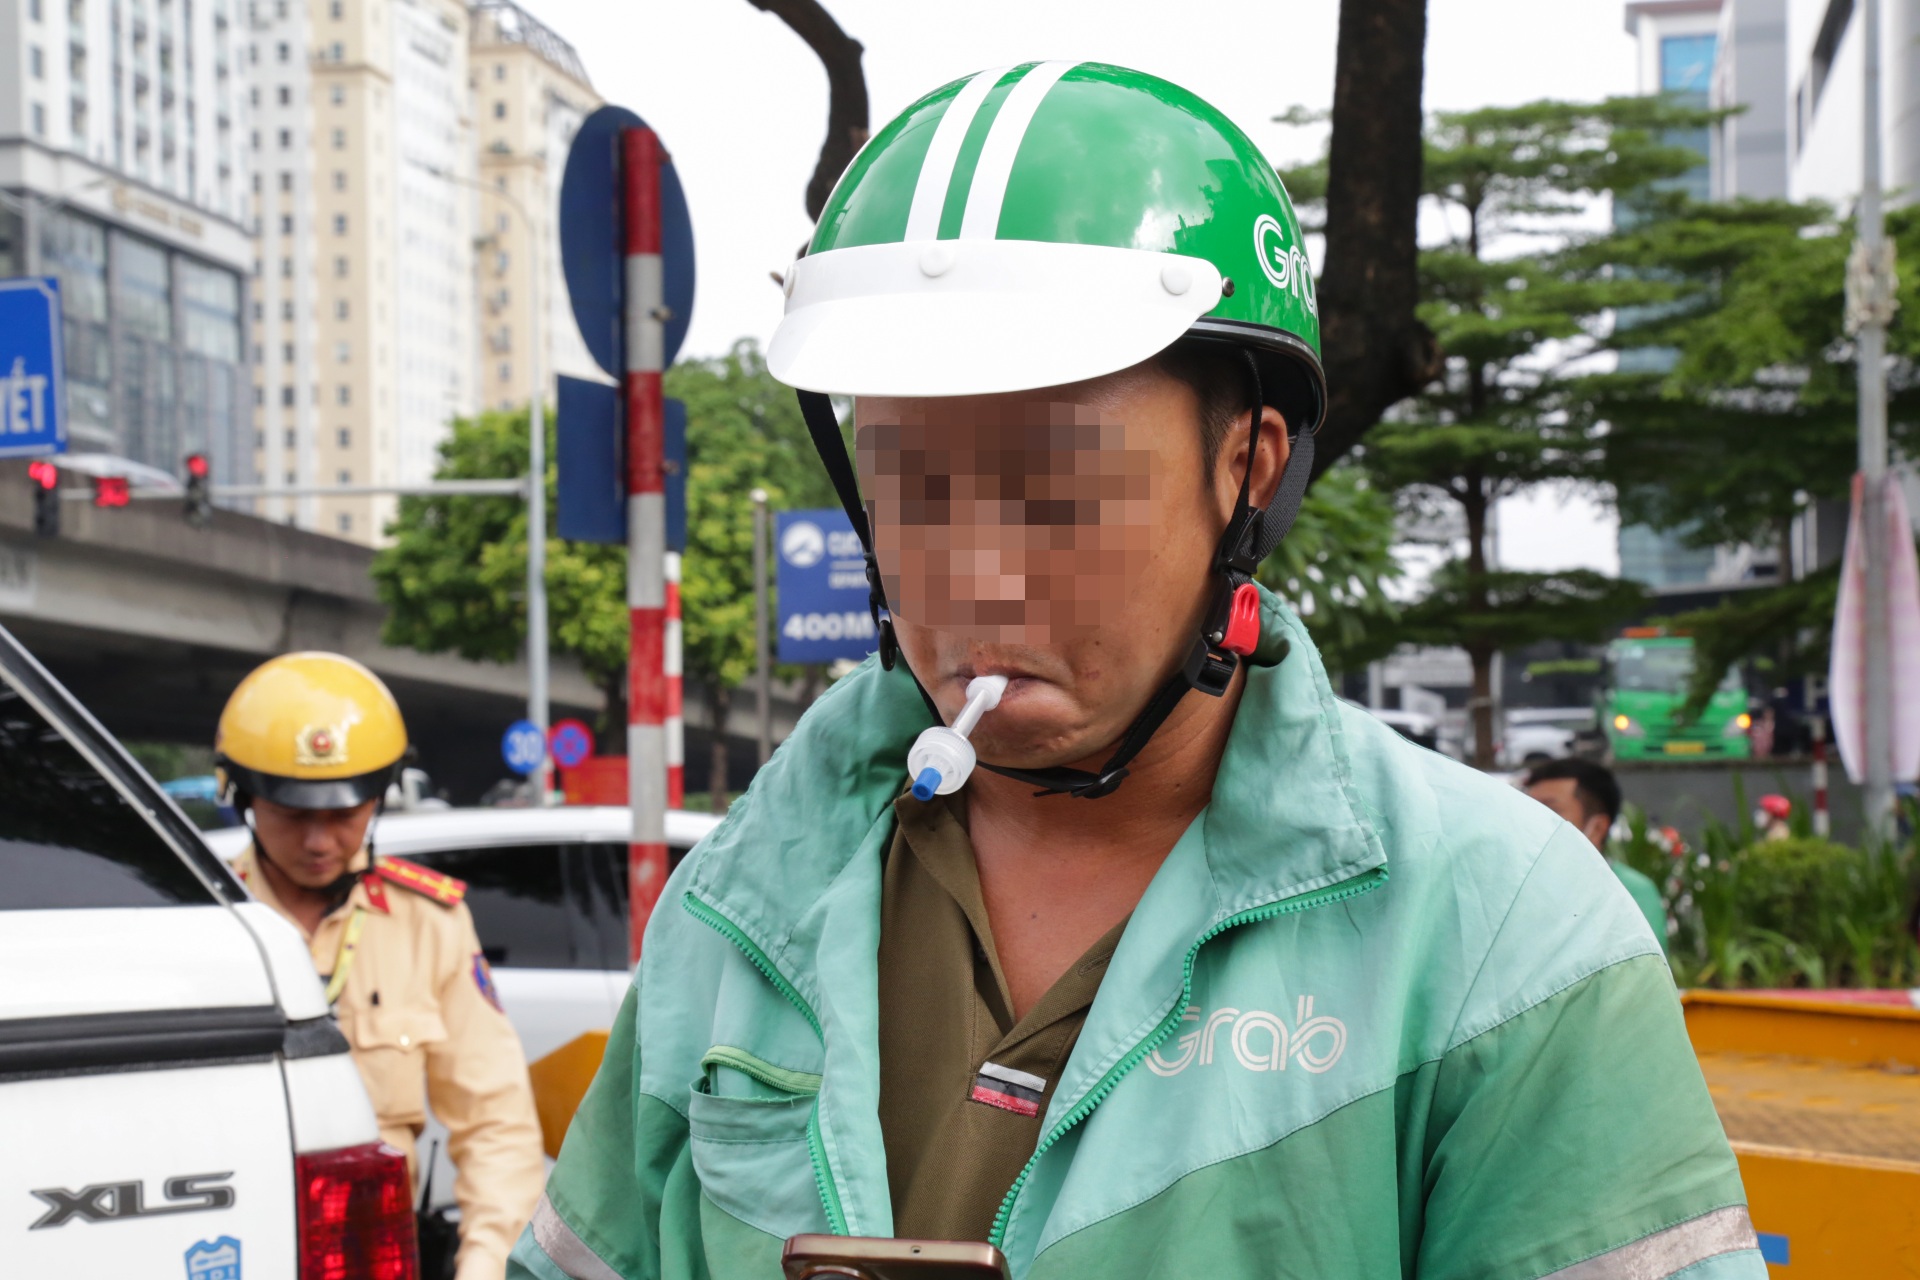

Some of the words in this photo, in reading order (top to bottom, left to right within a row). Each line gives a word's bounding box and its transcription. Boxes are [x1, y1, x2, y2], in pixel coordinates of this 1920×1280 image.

[508, 730, 544, 766] 30
[1144, 995, 1347, 1077] Grab
[28, 1170, 236, 1231] XLS
